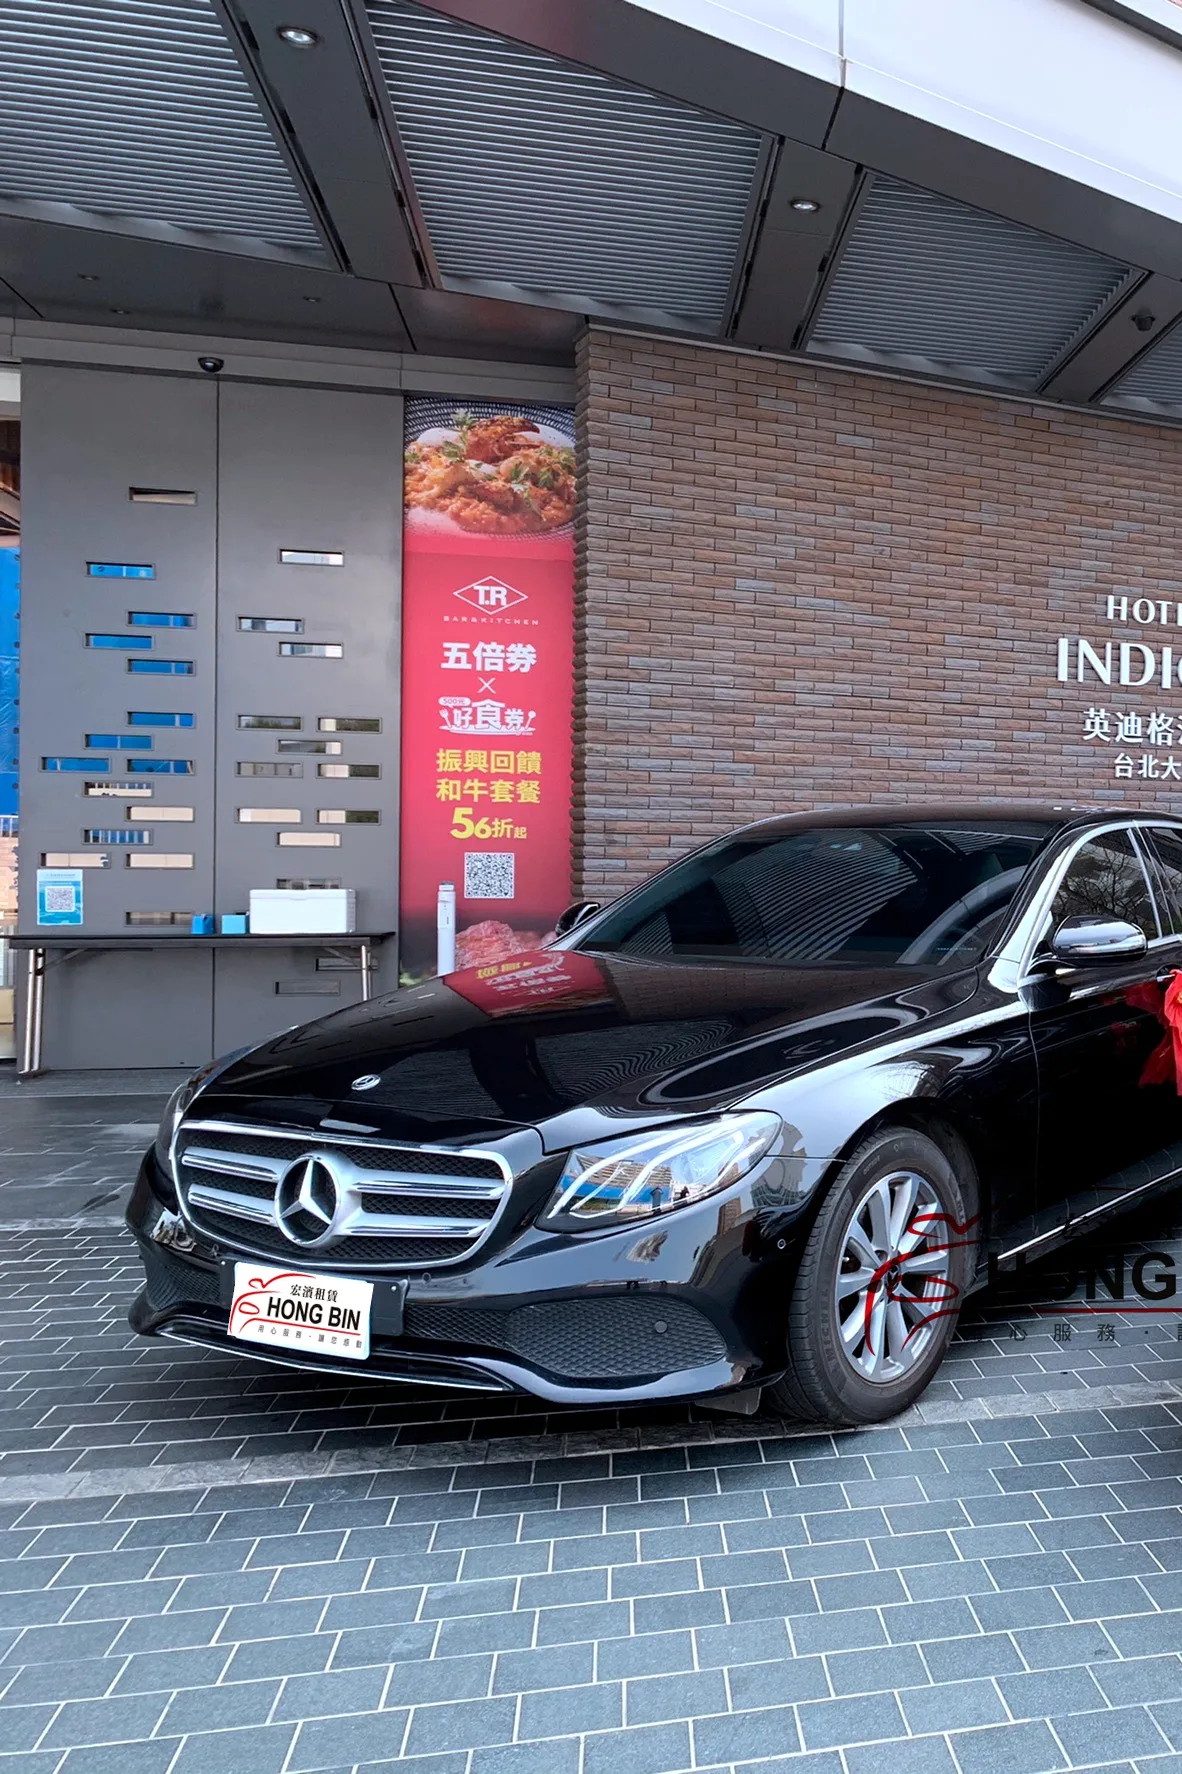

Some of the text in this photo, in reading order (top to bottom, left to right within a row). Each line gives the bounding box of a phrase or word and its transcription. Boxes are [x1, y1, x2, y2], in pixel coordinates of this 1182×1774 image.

[440, 641, 537, 673] 五倍券
[436, 748, 542, 774] 振興回饋
[436, 778, 541, 803] 和牛套餐
[450, 807, 527, 839] 56折起
[267, 1296, 361, 1331] HONG BIN
